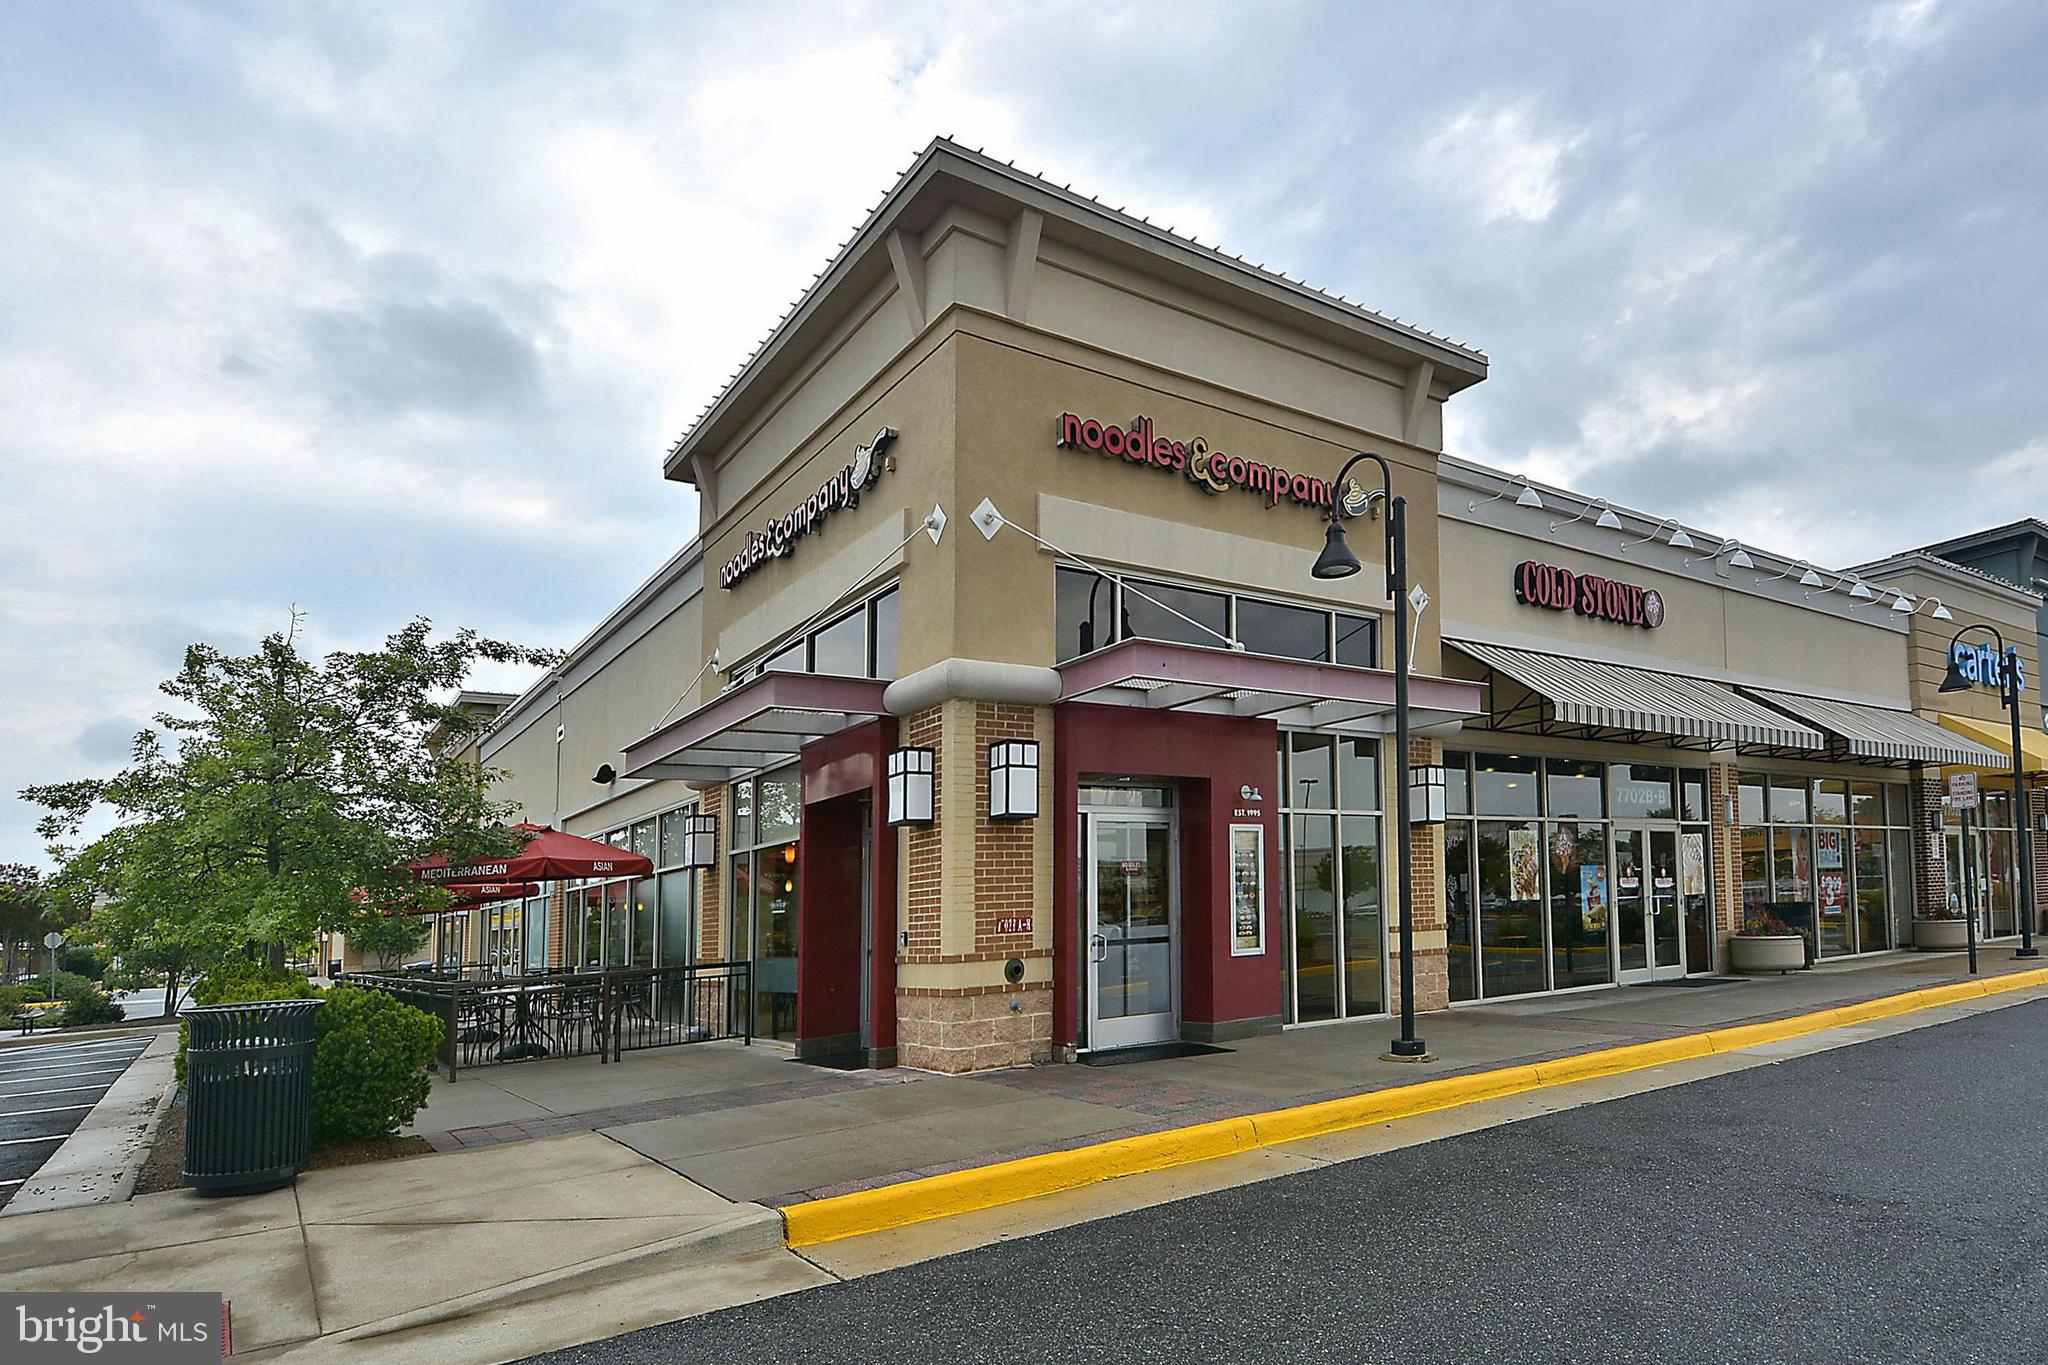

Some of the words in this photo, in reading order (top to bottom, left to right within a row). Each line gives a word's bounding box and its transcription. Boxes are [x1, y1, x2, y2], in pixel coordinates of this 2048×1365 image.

[1521, 561, 1576, 609] COLD
[1581, 574, 1643, 624] STONE
[1247, 809, 1261, 817] 1995
[1819, 831, 1836, 849] BIG
[593, 862, 613, 872] ASIAN
[481, 886, 501, 894] ASIAN
